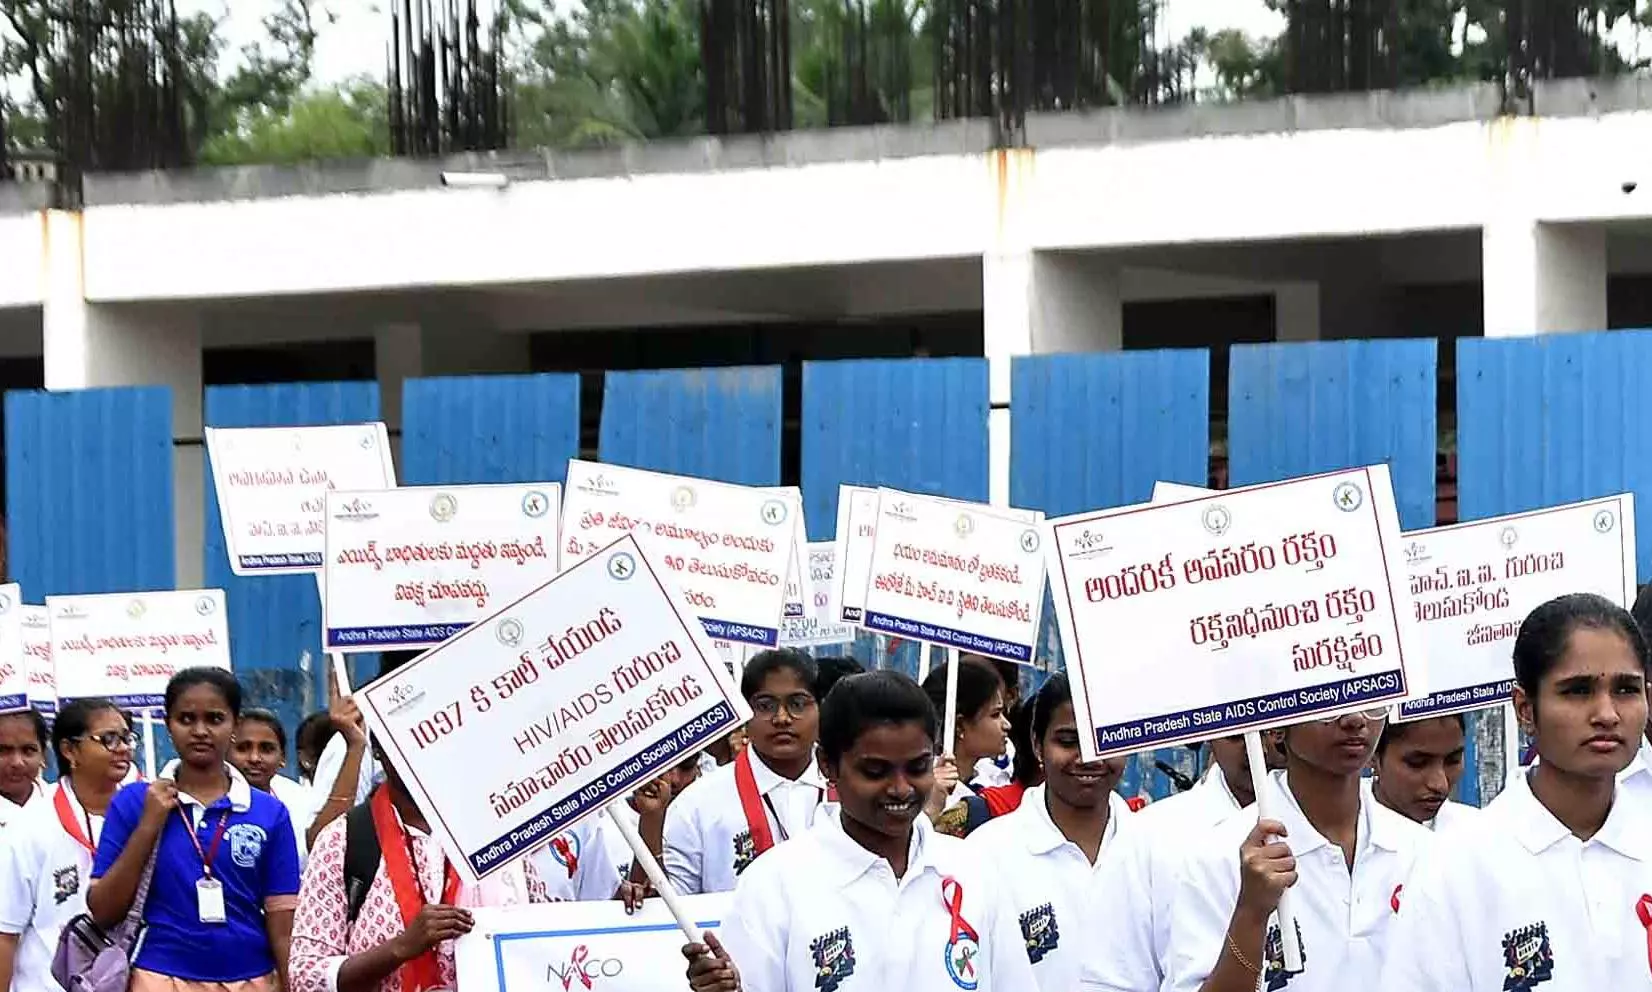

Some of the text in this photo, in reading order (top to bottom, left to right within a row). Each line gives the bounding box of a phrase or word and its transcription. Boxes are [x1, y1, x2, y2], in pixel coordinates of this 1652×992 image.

[1085, 531, 1336, 602] అందరికీ అవసరం రక్తం
[1190, 587, 1374, 651] రక్తనిధినుంచి రక్తం
[1293, 632, 1382, 672] సురక్షితం
[410, 702, 462, 749] 1097
[491, 651, 538, 699] కాల్
[541, 608, 621, 669] చేయండి
[1102, 673, 1398, 743] Andhra Pradesh State AIDS Control Society (APSACS)
[1404, 693, 1435, 710] Andhra
[1436, 687, 1471, 705] Pradesh
[1473, 685, 1494, 699] State
[490, 675, 703, 818] సమాచారం తెలుసుకోండి
[514, 684, 613, 754] HIV/AIDS
[476, 706, 728, 867] Andhra Pradesh State AIDS Control Society (APSACS)
[547, 945, 622, 992] NACO
